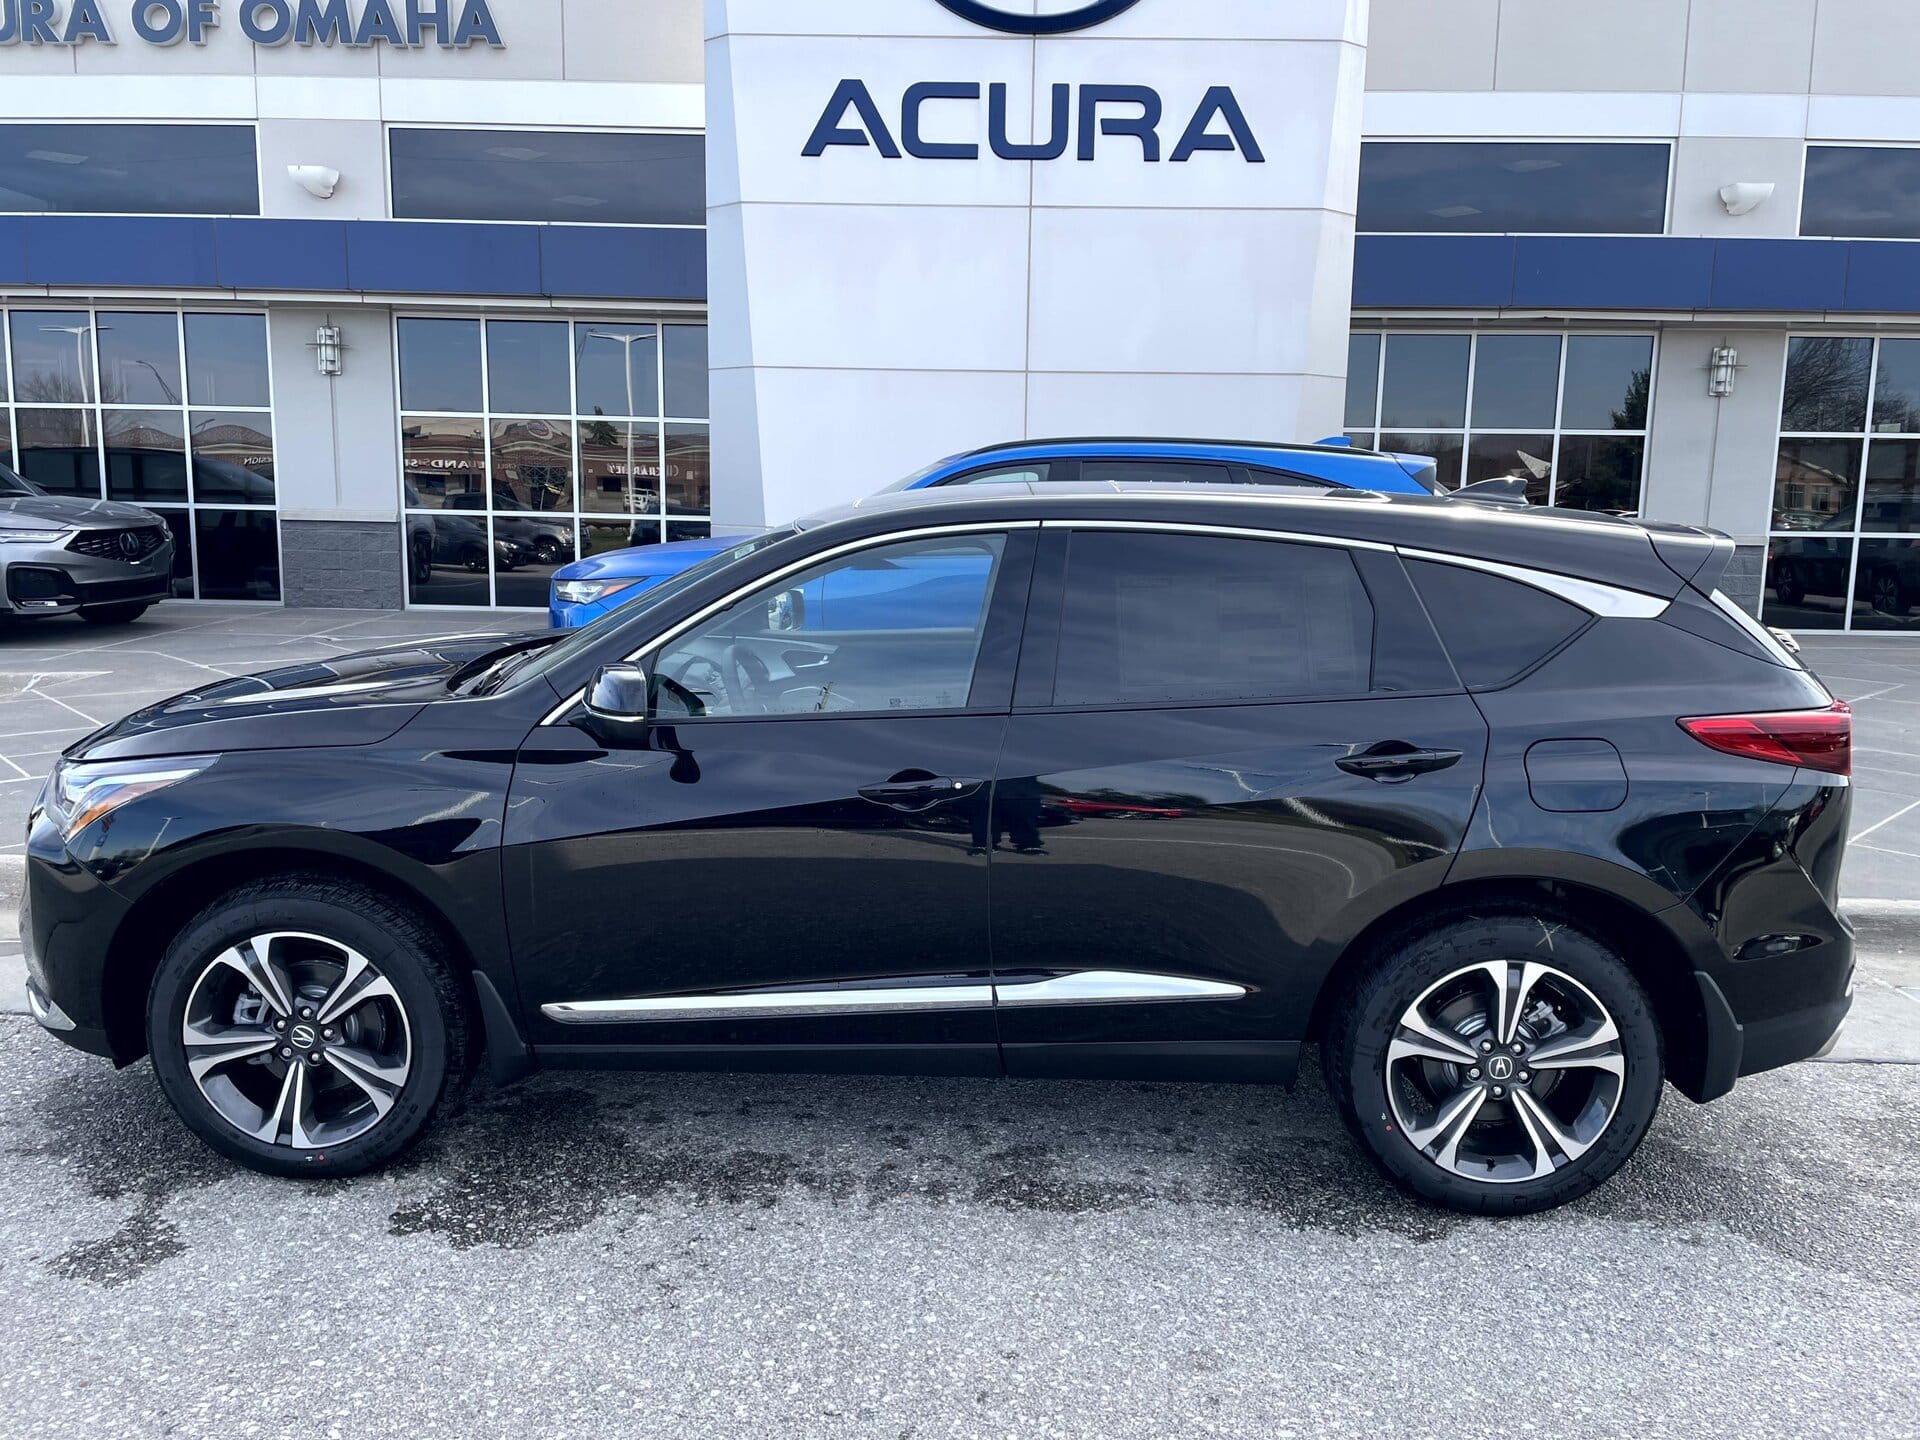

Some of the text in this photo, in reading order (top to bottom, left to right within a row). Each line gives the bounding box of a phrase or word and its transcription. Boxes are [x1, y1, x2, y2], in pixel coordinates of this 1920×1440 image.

[131, 0, 215, 45] OF
[239, 0, 502, 47] OMAHA
[801, 78, 1265, 163] ACURA
